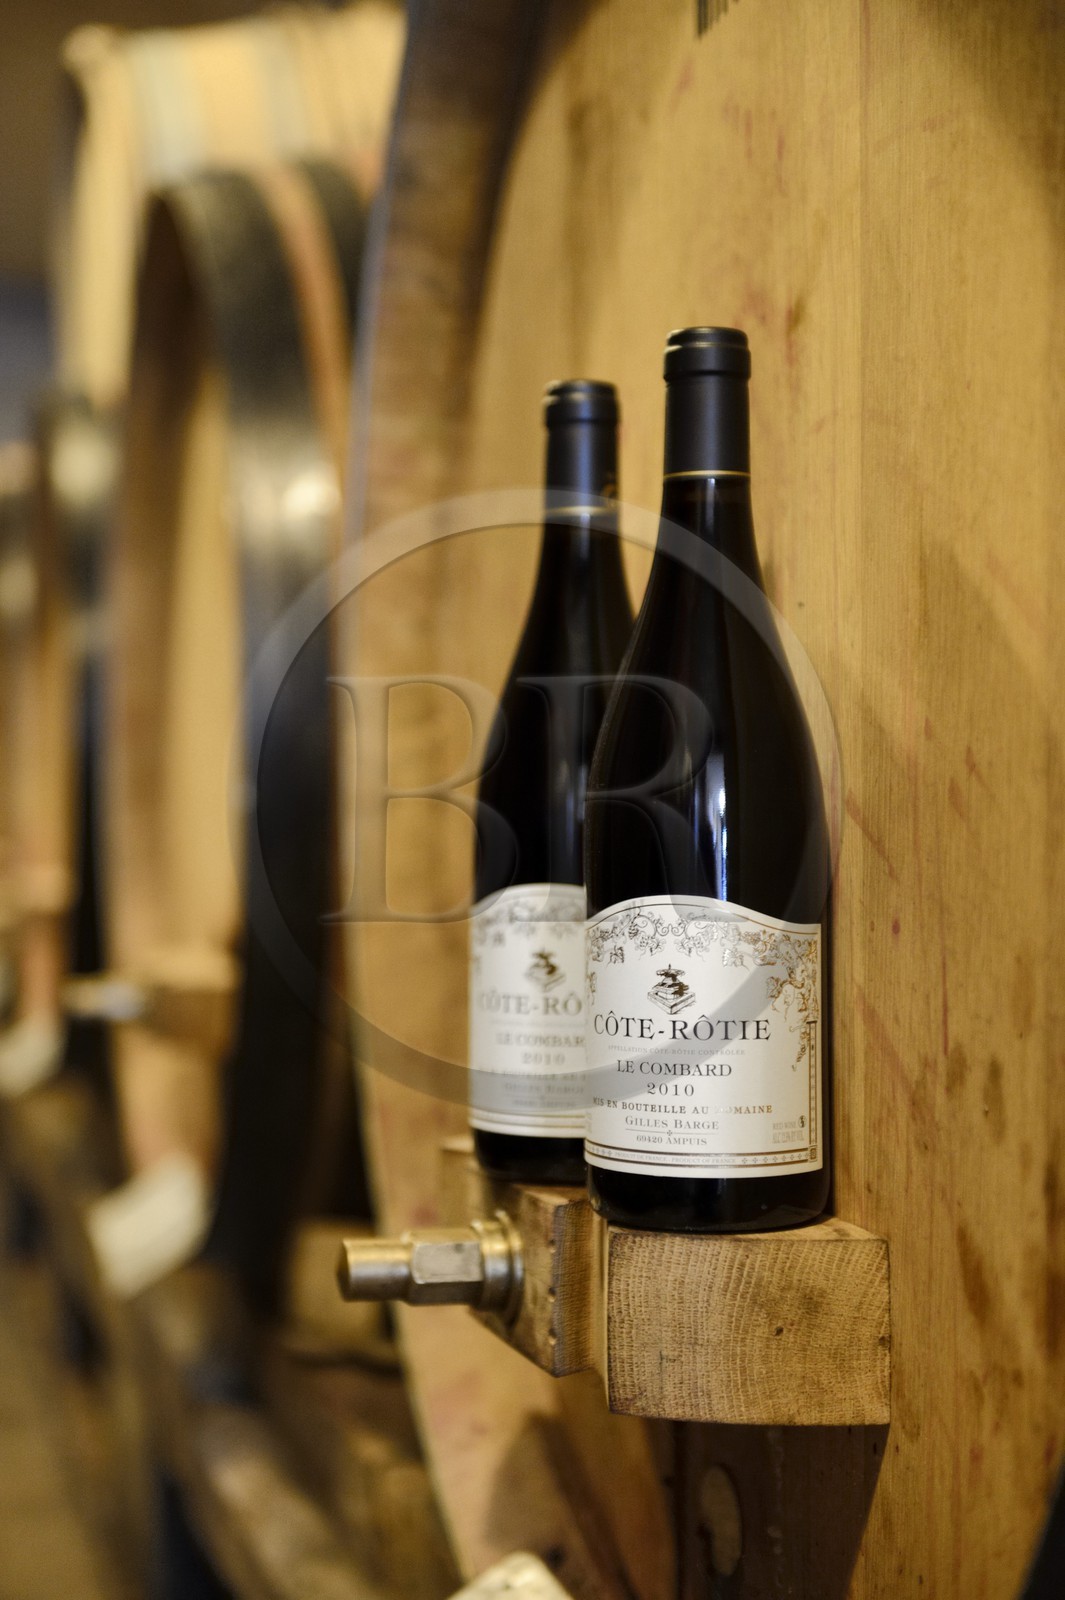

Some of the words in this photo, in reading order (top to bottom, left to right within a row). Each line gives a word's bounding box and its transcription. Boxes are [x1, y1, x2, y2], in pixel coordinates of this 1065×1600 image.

[593, 1010, 772, 1042] CÔTE-RÔTIE
[616, 1059, 635, 1074] LE
[639, 1061, 733, 1077] COMBARD
[646, 1082, 695, 1097] 2010
[607, 1099, 618, 1109] EN
[621, 1101, 687, 1114] BOUTEILLE
[692, 1105, 710, 1115] AU
[714, 1103, 773, 1115] OMAINE
[625, 1115, 668, 1129] GILLES
[674, 1118, 720, 1131] BARGE
[665, 1136, 708, 1146] AMPUIS
